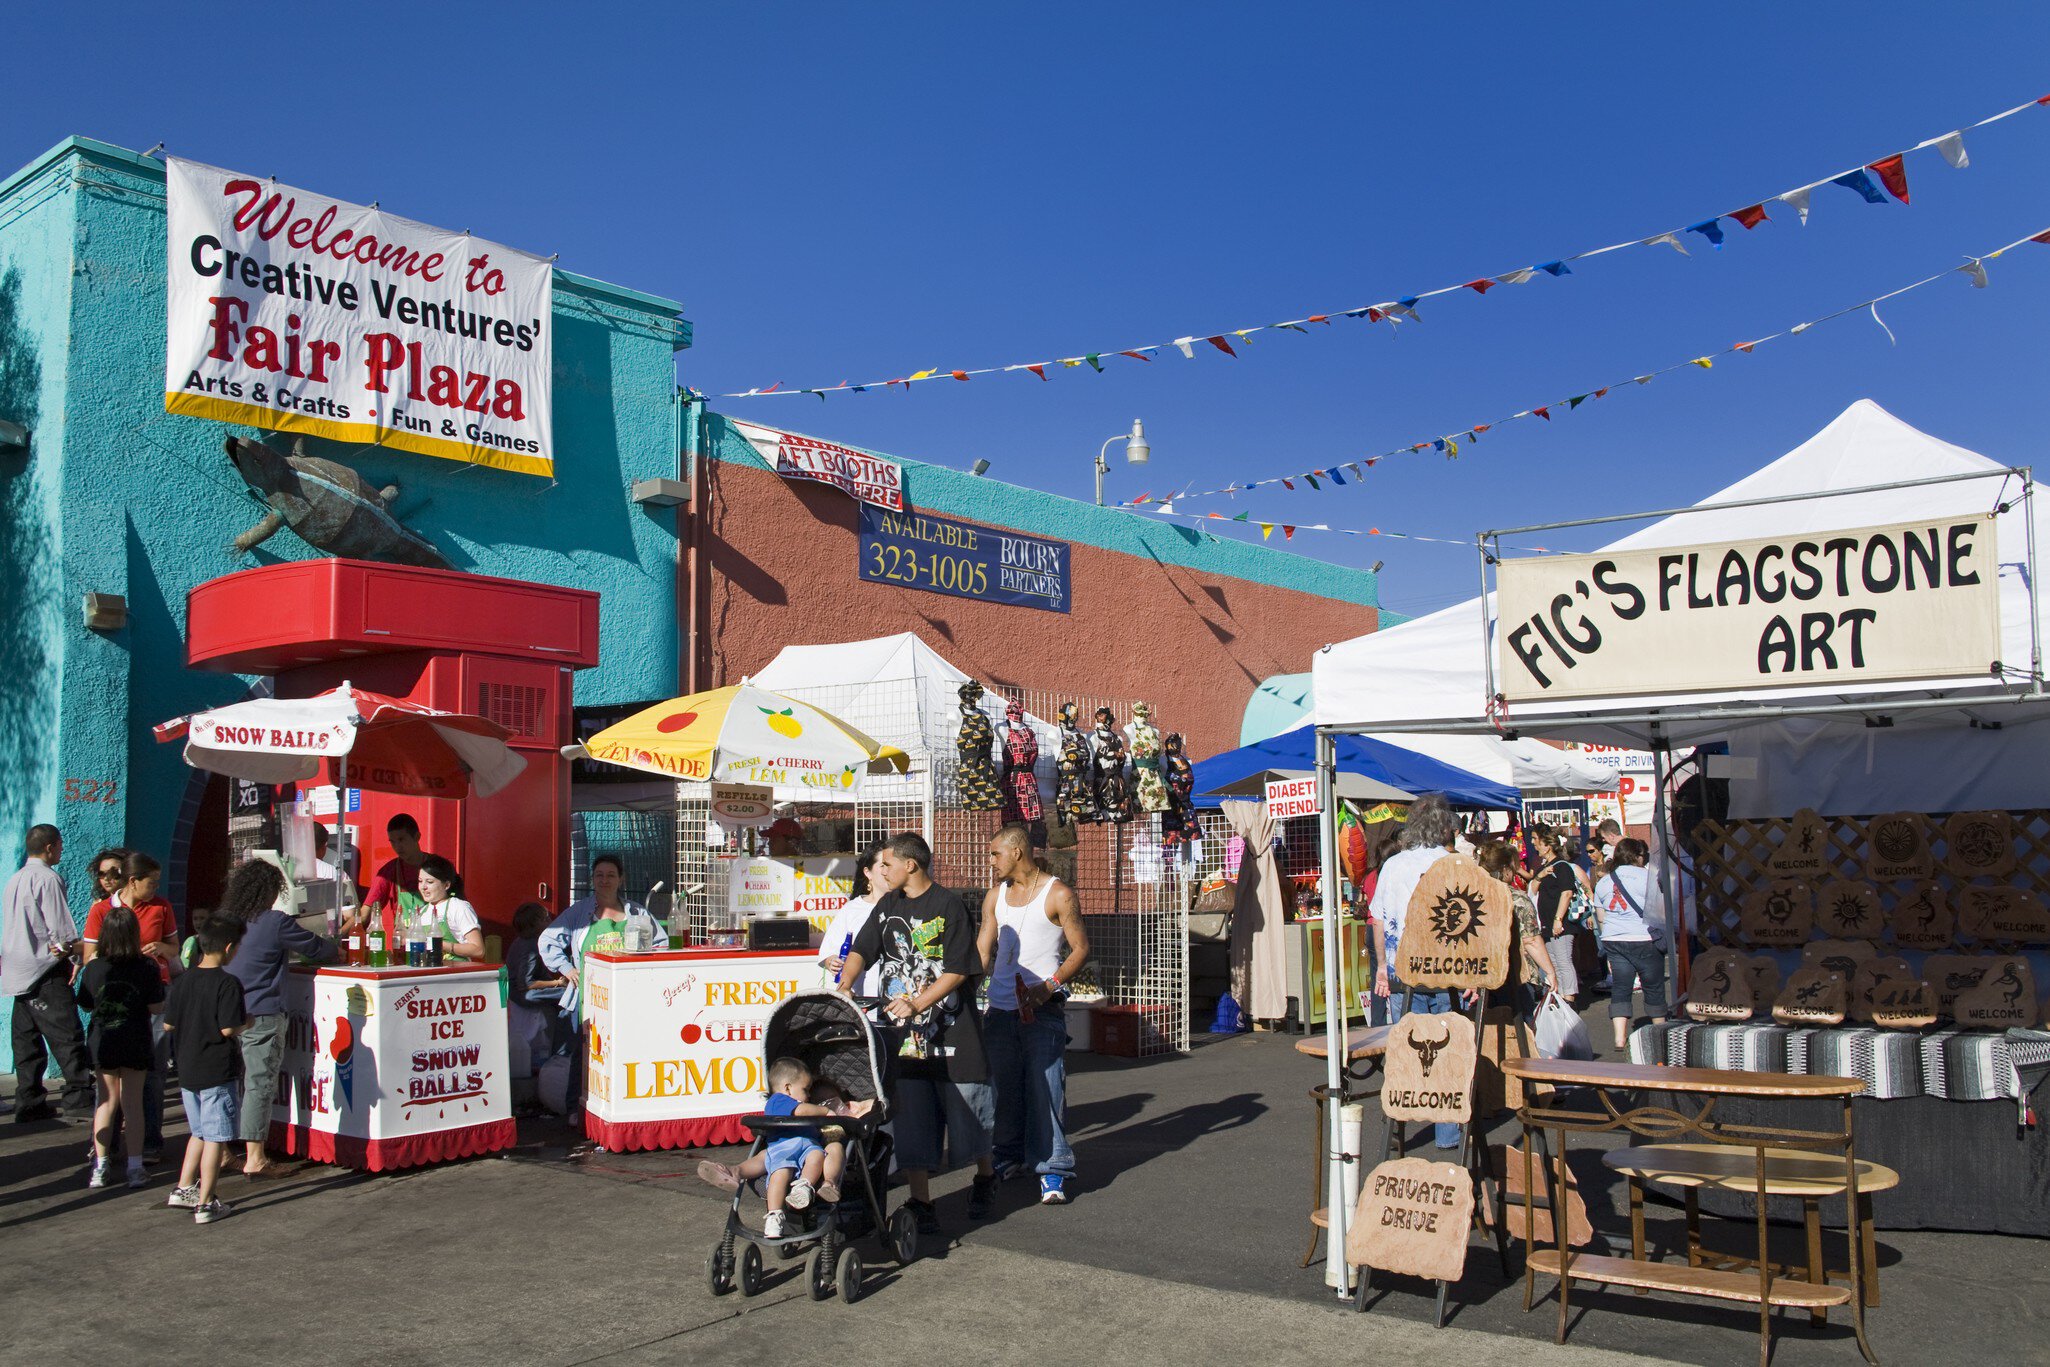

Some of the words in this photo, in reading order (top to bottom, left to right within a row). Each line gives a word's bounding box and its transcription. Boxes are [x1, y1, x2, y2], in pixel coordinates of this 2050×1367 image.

[224, 179, 444, 282] Welcome
[465, 254, 506, 295] to
[190, 234, 358, 311] Creative
[371, 279, 540, 352] Ventures'
[208, 296, 341, 383] Fair
[363, 333, 526, 422] Plaza
[184, 369, 244, 398] Arts
[251, 382, 270, 403] &
[276, 387, 351, 419] Crafts
[392, 407, 432, 433] Fun
[440, 419, 457, 439] &
[465, 423, 540, 454] Games
[818, 450, 898, 487] BOOTHS
[853, 483, 900, 508] HERE
[880, 511, 978, 550] AVAILABLE
[1000, 537, 1060, 574] BOURN
[869, 542, 988, 595] 323-1005
[1507, 560, 1646, 689] FIG'S
[1659, 523, 1981, 612] FLAGSTONE
[1757, 609, 1877, 674] ART
[215, 726, 265, 746] SNOW
[270, 729, 329, 750] BALLS
[728, 756, 761, 771] FRESH
[777, 757, 825, 770] CHERRY
[64, 777, 118, 805] 522
[717, 790, 768, 801] REFILLS
[727, 804, 755, 813] $2.00
[1773, 858, 1819, 870] WELCOME
[1874, 866, 1923, 877] WELCOME
[1754, 928, 1800, 938] WELCOME
[1896, 933, 1947, 944] WELCOME
[1993, 921, 2046, 933] WELCOME
[1409, 956, 1489, 975] WELCOME
[704, 980, 798, 1007] FRESH
[406, 994, 486, 1019] SHAVED
[1695, 1003, 1744, 1014] WELCOME
[1782, 1006, 1836, 1016] WELCOME
[1878, 1007, 1931, 1020] WELCOME
[1969, 1009, 2025, 1020] WELCOME
[430, 1020, 464, 1040] ICE
[412, 1044, 481, 1073] SNOW
[408, 1068, 484, 1100] BALLS
[1389, 1090, 1464, 1110] WELCOME
[1374, 1175, 1456, 1206] PRIVATE
[1381, 1206, 1438, 1233] DRIVE
